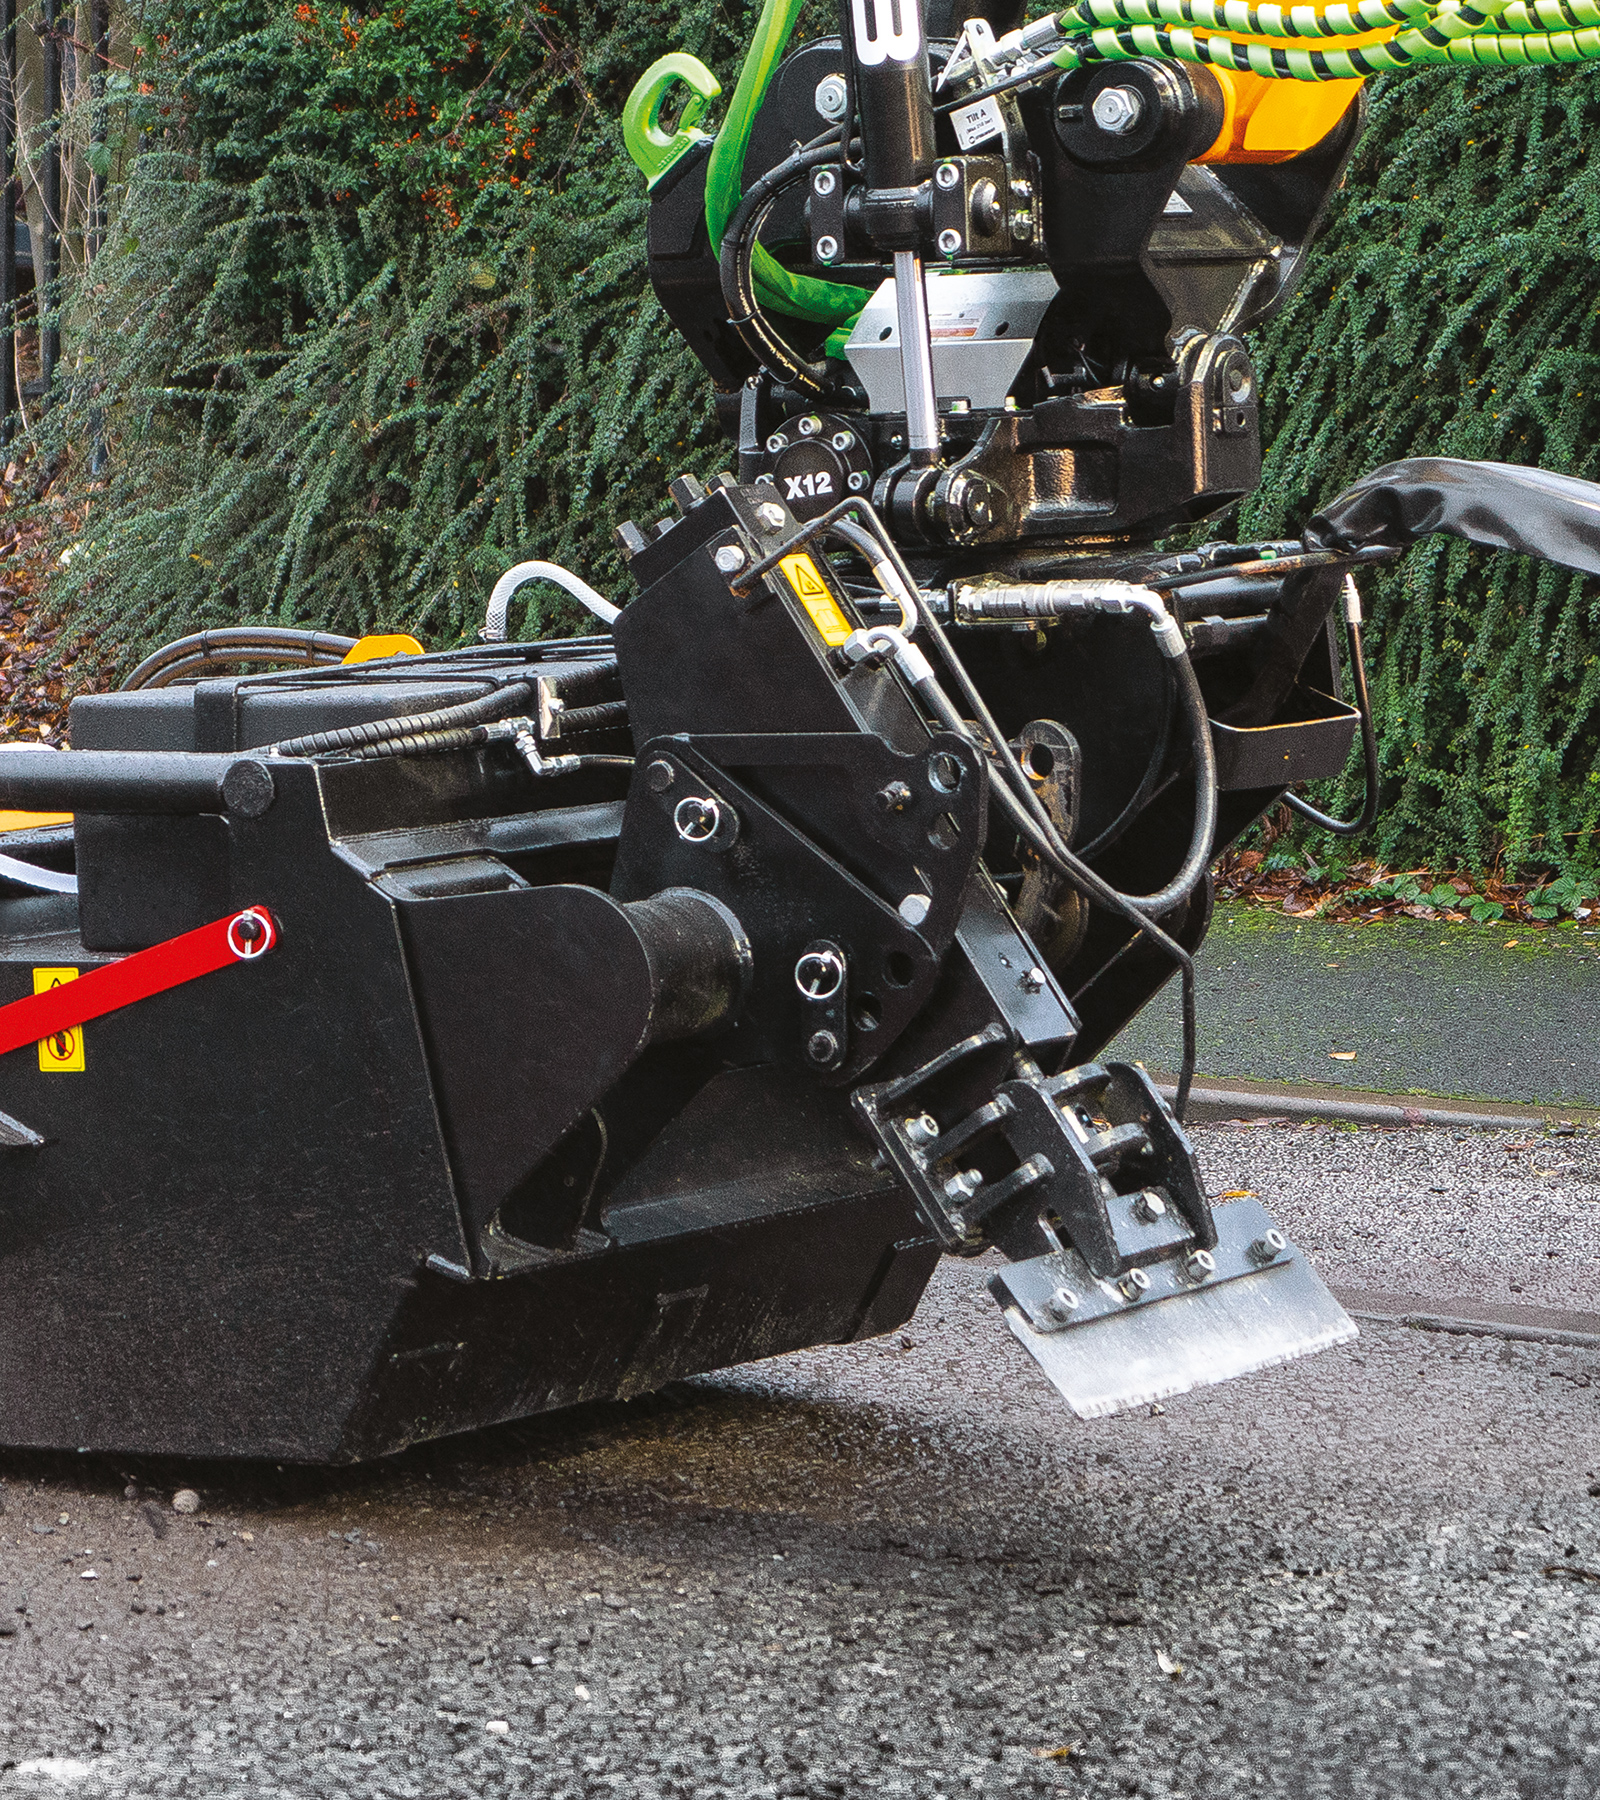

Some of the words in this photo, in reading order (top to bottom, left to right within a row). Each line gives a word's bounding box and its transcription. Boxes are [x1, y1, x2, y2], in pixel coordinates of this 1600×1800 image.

[966, 113, 979, 123] Tilt
[981, 109, 986, 117] A
[783, 471, 833, 500] X12
